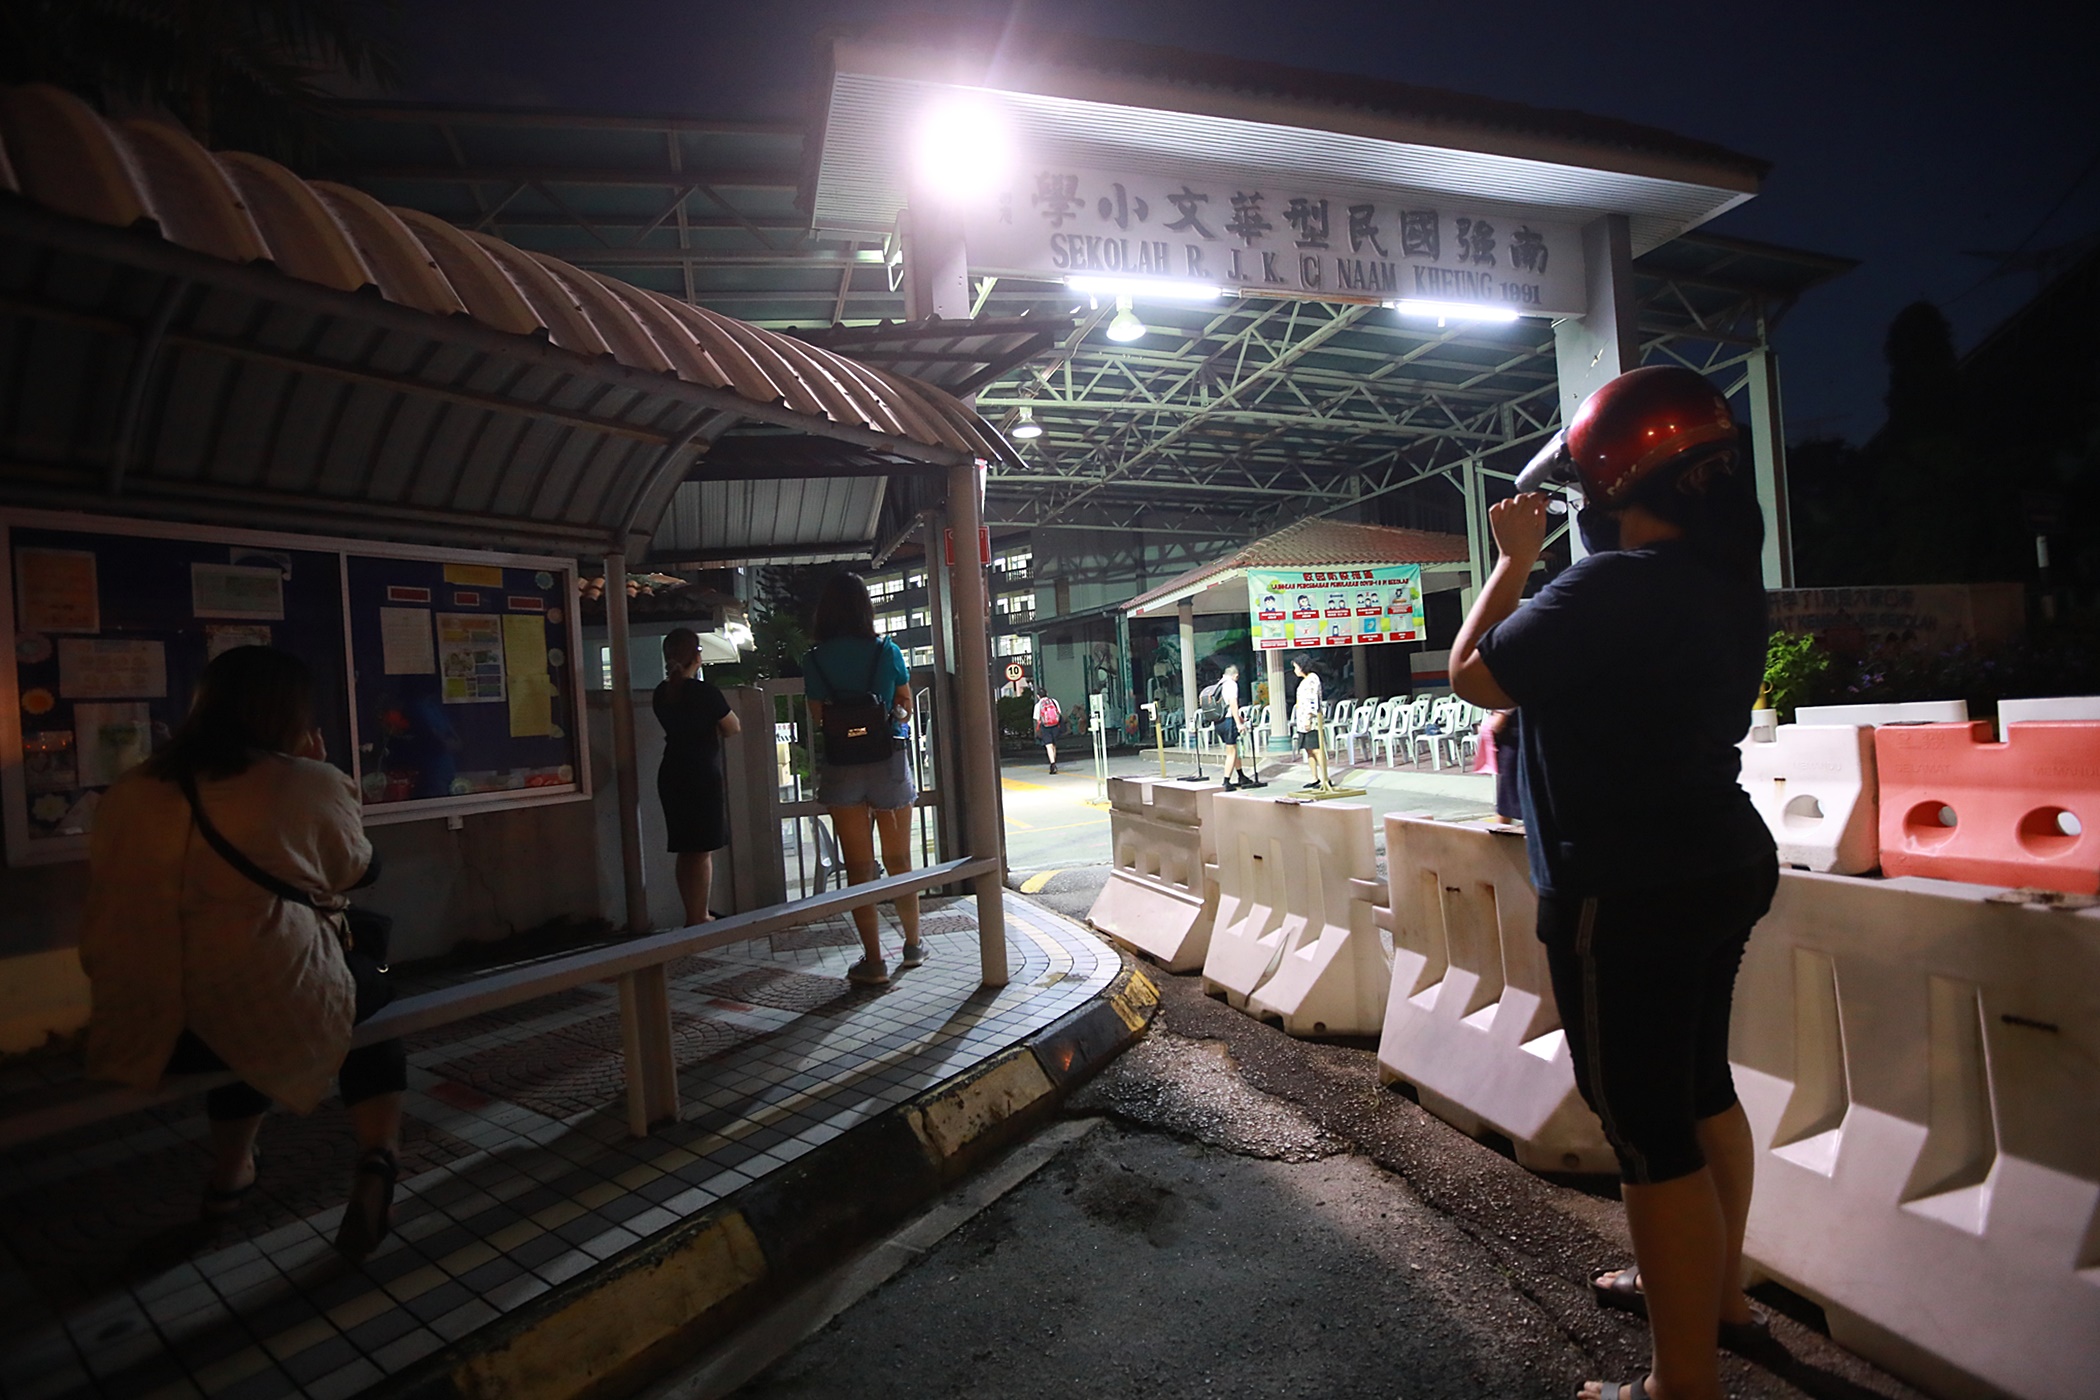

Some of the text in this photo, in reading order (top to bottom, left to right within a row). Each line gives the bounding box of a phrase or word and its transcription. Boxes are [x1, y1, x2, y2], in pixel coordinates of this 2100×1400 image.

[1050, 232, 1170, 274] SEKOLAH
[1185, 244, 1210, 277] R.
[1226, 248, 1248, 281] J.
[1261, 251, 1286, 284] K.
[1336, 257, 1398, 292] NAAM
[1412, 264, 1493, 299] KHEUNG
[1500, 282, 1543, 305] 1991
[1008, 666, 1020, 675] 10
